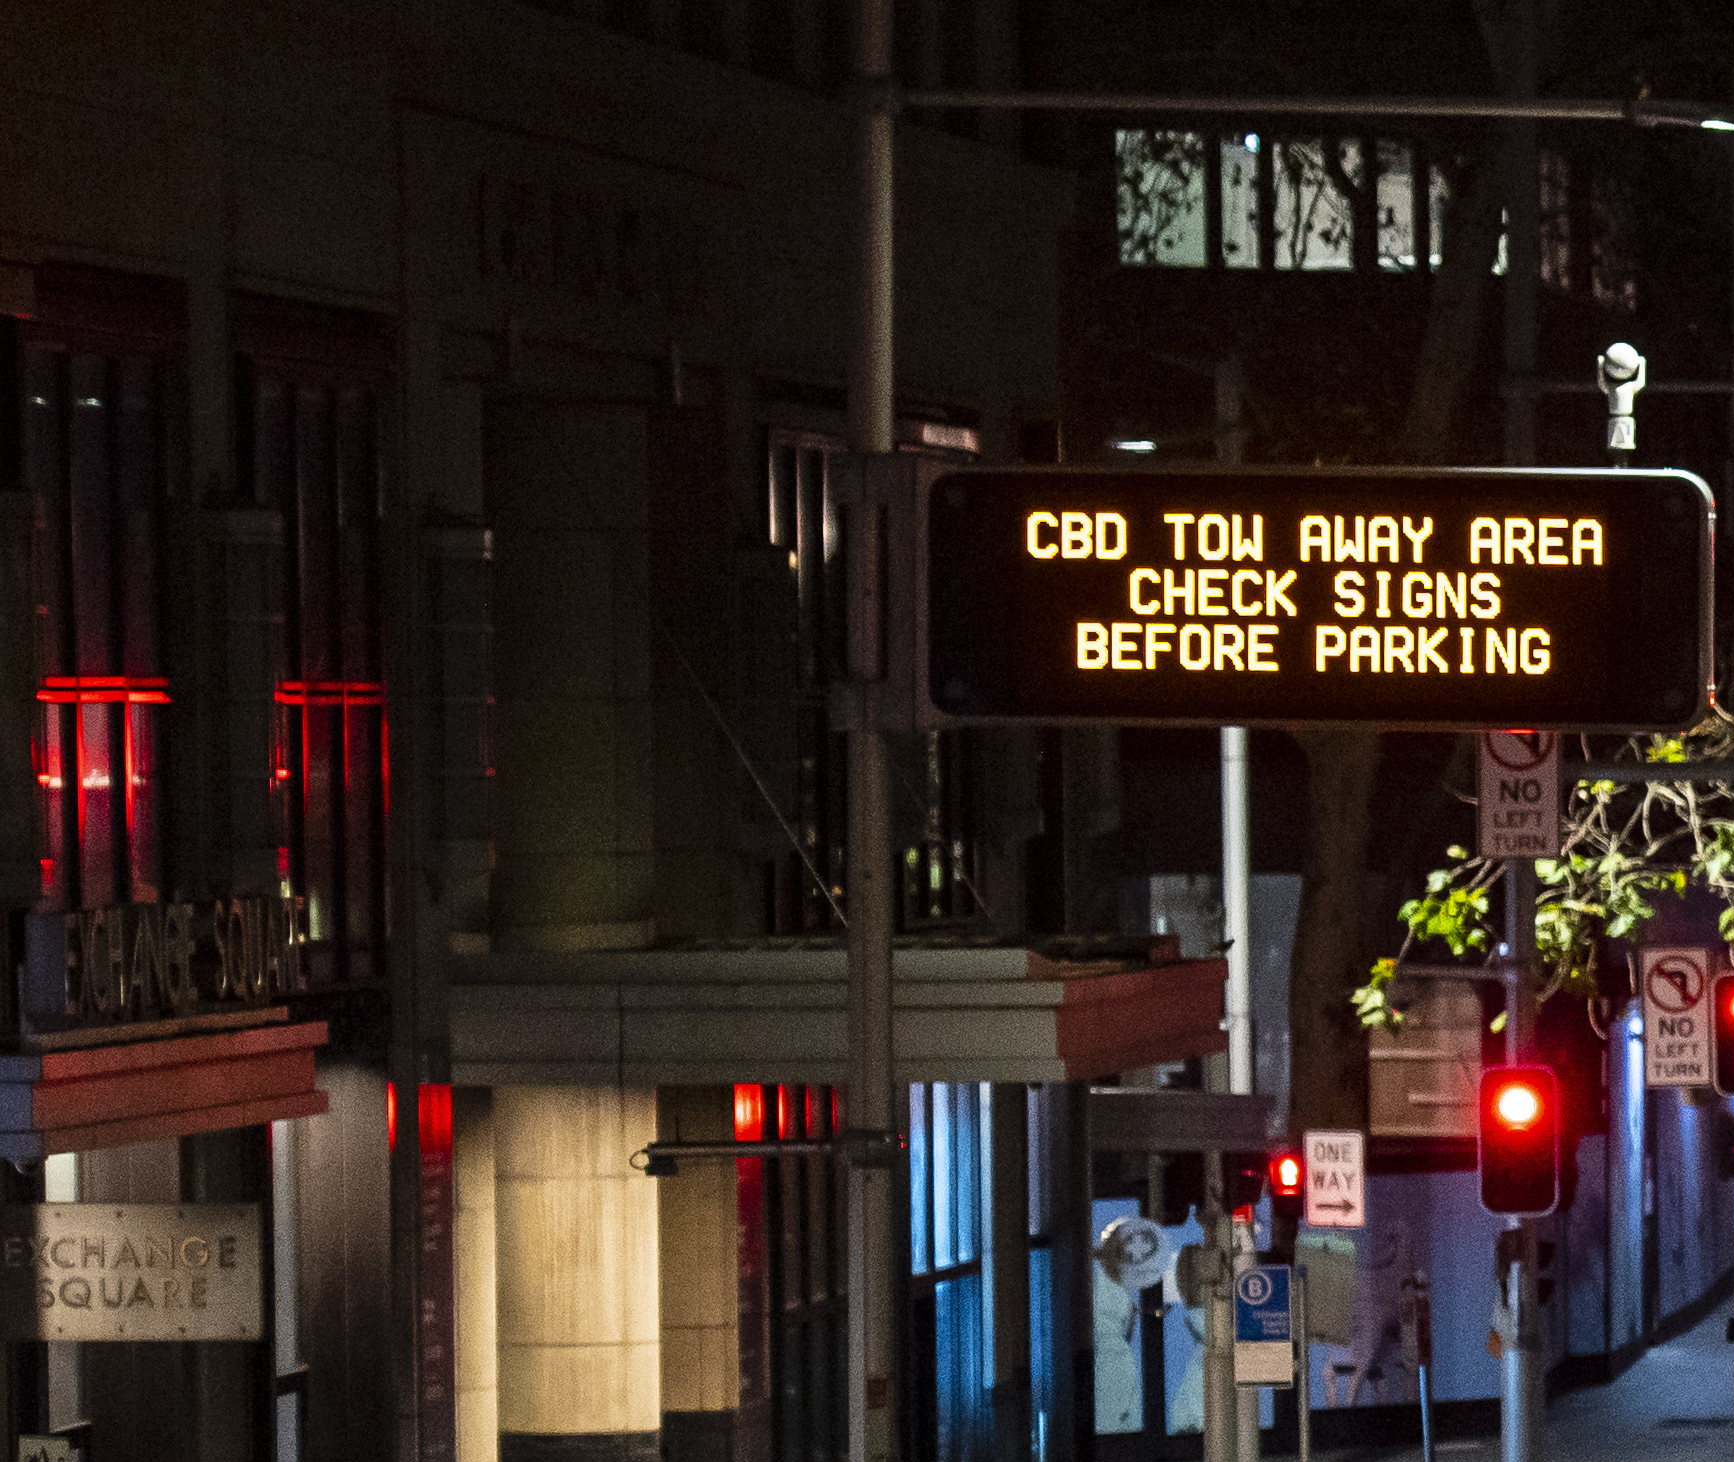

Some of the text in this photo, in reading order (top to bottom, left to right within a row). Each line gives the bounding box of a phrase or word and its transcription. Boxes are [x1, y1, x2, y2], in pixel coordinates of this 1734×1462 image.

[1026, 511, 1604, 566] CBD TOW AWAY AREA
[1129, 567, 1502, 620] CHECK SIGNS
[1076, 622, 1551, 675] BEFORE PARKING
[1499, 778, 1543, 804] NO
[1493, 810, 1544, 829] LEFT
[1492, 833, 1548, 852] TURN
[64, 895, 308, 1015] EXCHANGE SQUARE
[1658, 1016, 1695, 1038] NO
[1654, 1042, 1699, 1058] LEFT
[1654, 1062, 1702, 1078] TURN
[1314, 1142, 1351, 1162] ONE
[1311, 1170, 1356, 1191] WAY
[3, 1235, 237, 1271] EXCHANGE
[36, 1276, 208, 1311] SQUARE
